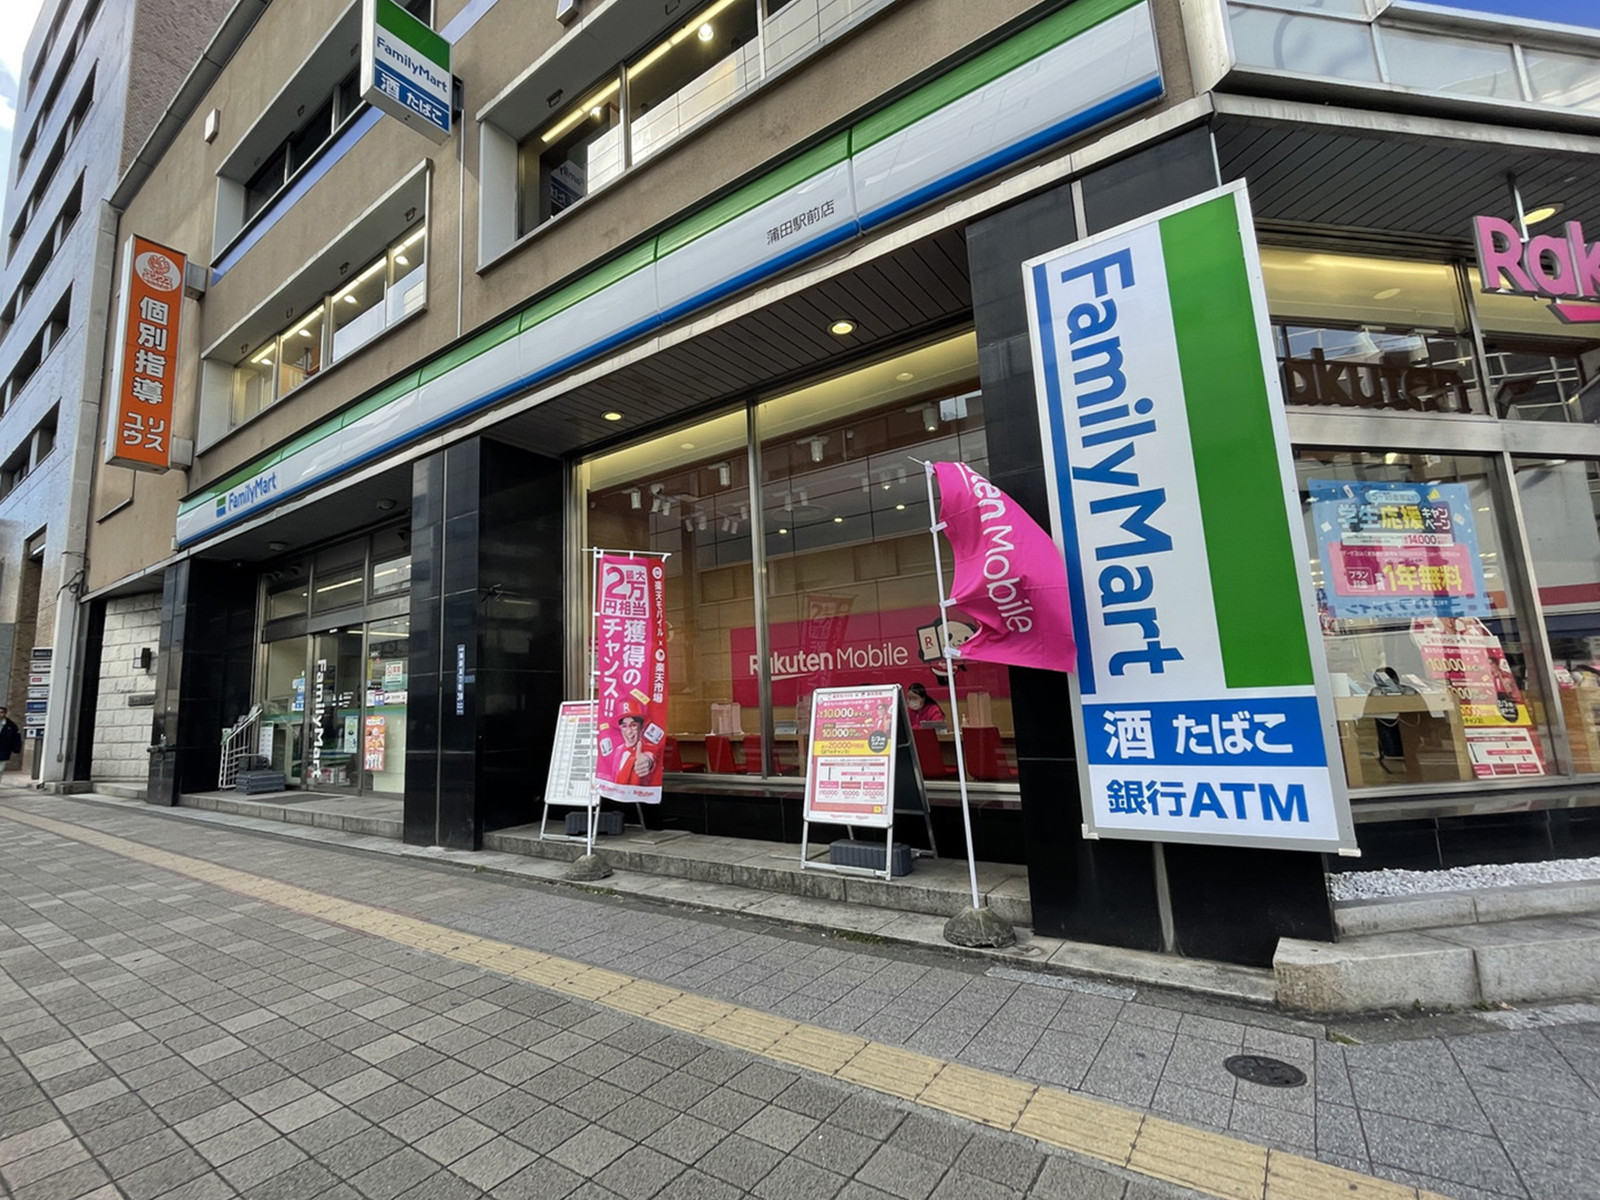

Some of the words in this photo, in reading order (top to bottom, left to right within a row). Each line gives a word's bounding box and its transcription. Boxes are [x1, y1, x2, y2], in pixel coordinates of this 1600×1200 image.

[376, 36, 448, 93] FamilyMart
[380, 73, 402, 100] 酒
[406, 92, 443, 125] たばこ
[766, 199, 835, 245] 蒲田駅前店
[1472, 215, 1600, 298] Rak
[133, 296, 169, 404] 個別指導
[1061, 247, 1184, 677] FamilyMart
[228, 472, 276, 511] FamilyMart
[1338, 504, 1424, 529] 学生応援
[982, 525, 1034, 633] Mobile
[1383, 564, 1462, 591] 1年無料
[602, 599, 646, 618] 円相当
[622, 618, 647, 687] 獲得の
[749, 651, 833, 676] Rkuten
[836, 642, 909, 670] Mobile
[924, 636, 934, 648] R
[312, 658, 327, 780] FamilyMart
[1103, 710, 1155, 759] 酒
[1172, 710, 1293, 754] たばこ
[1106, 779, 1310, 822] 銀行ATM
